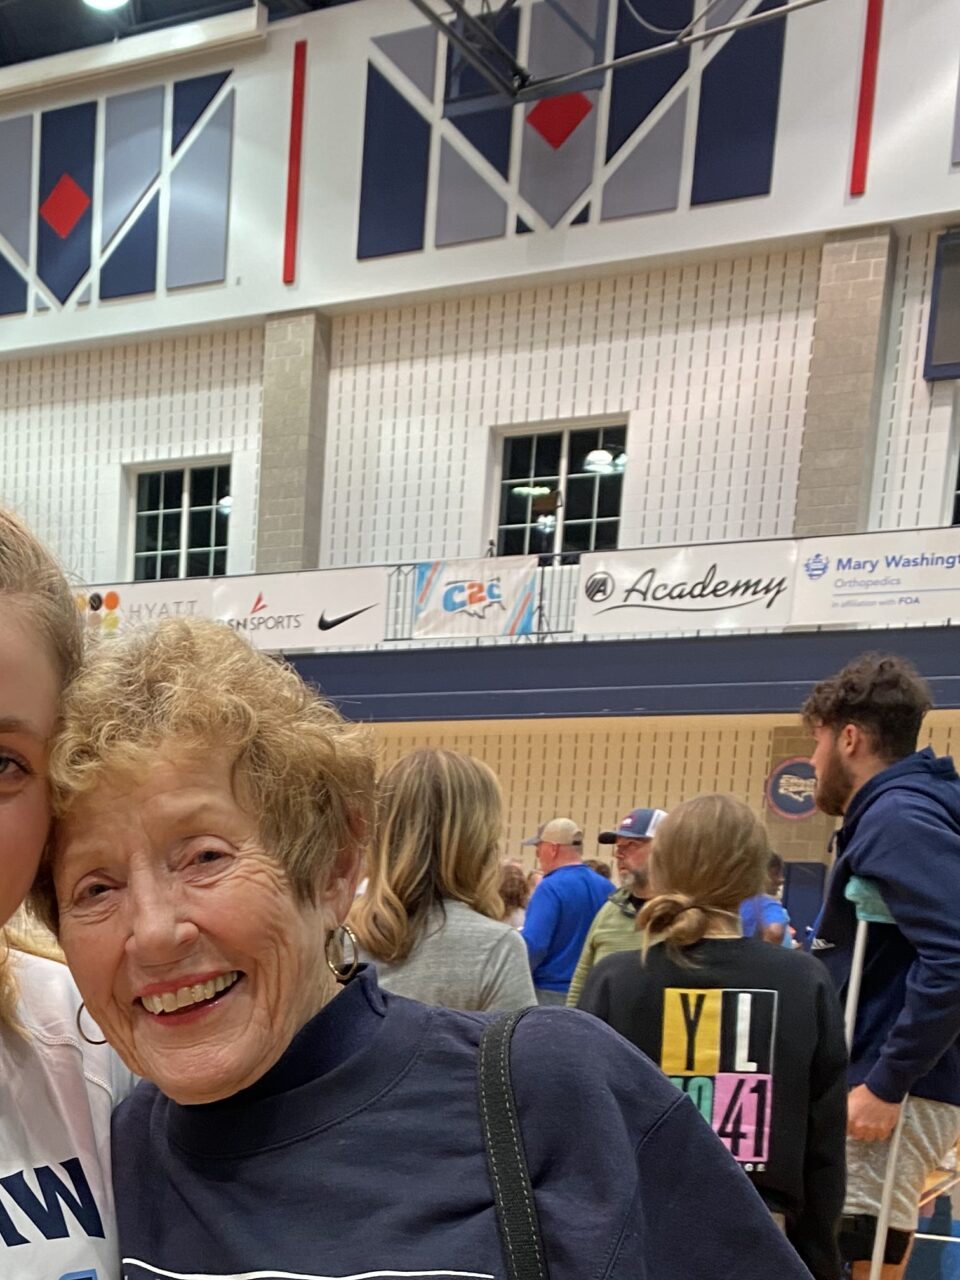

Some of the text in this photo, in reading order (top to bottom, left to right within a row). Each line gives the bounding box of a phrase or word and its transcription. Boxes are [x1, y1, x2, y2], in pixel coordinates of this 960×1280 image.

[836, 557, 880, 573] Mary
[624, 563, 788, 609] Academy
[834, 576, 901, 589] Orthopedics
[129, 600, 199, 620] HYATT
[442, 581, 502, 613] C2C
[717, 1078, 768, 1158] 41
